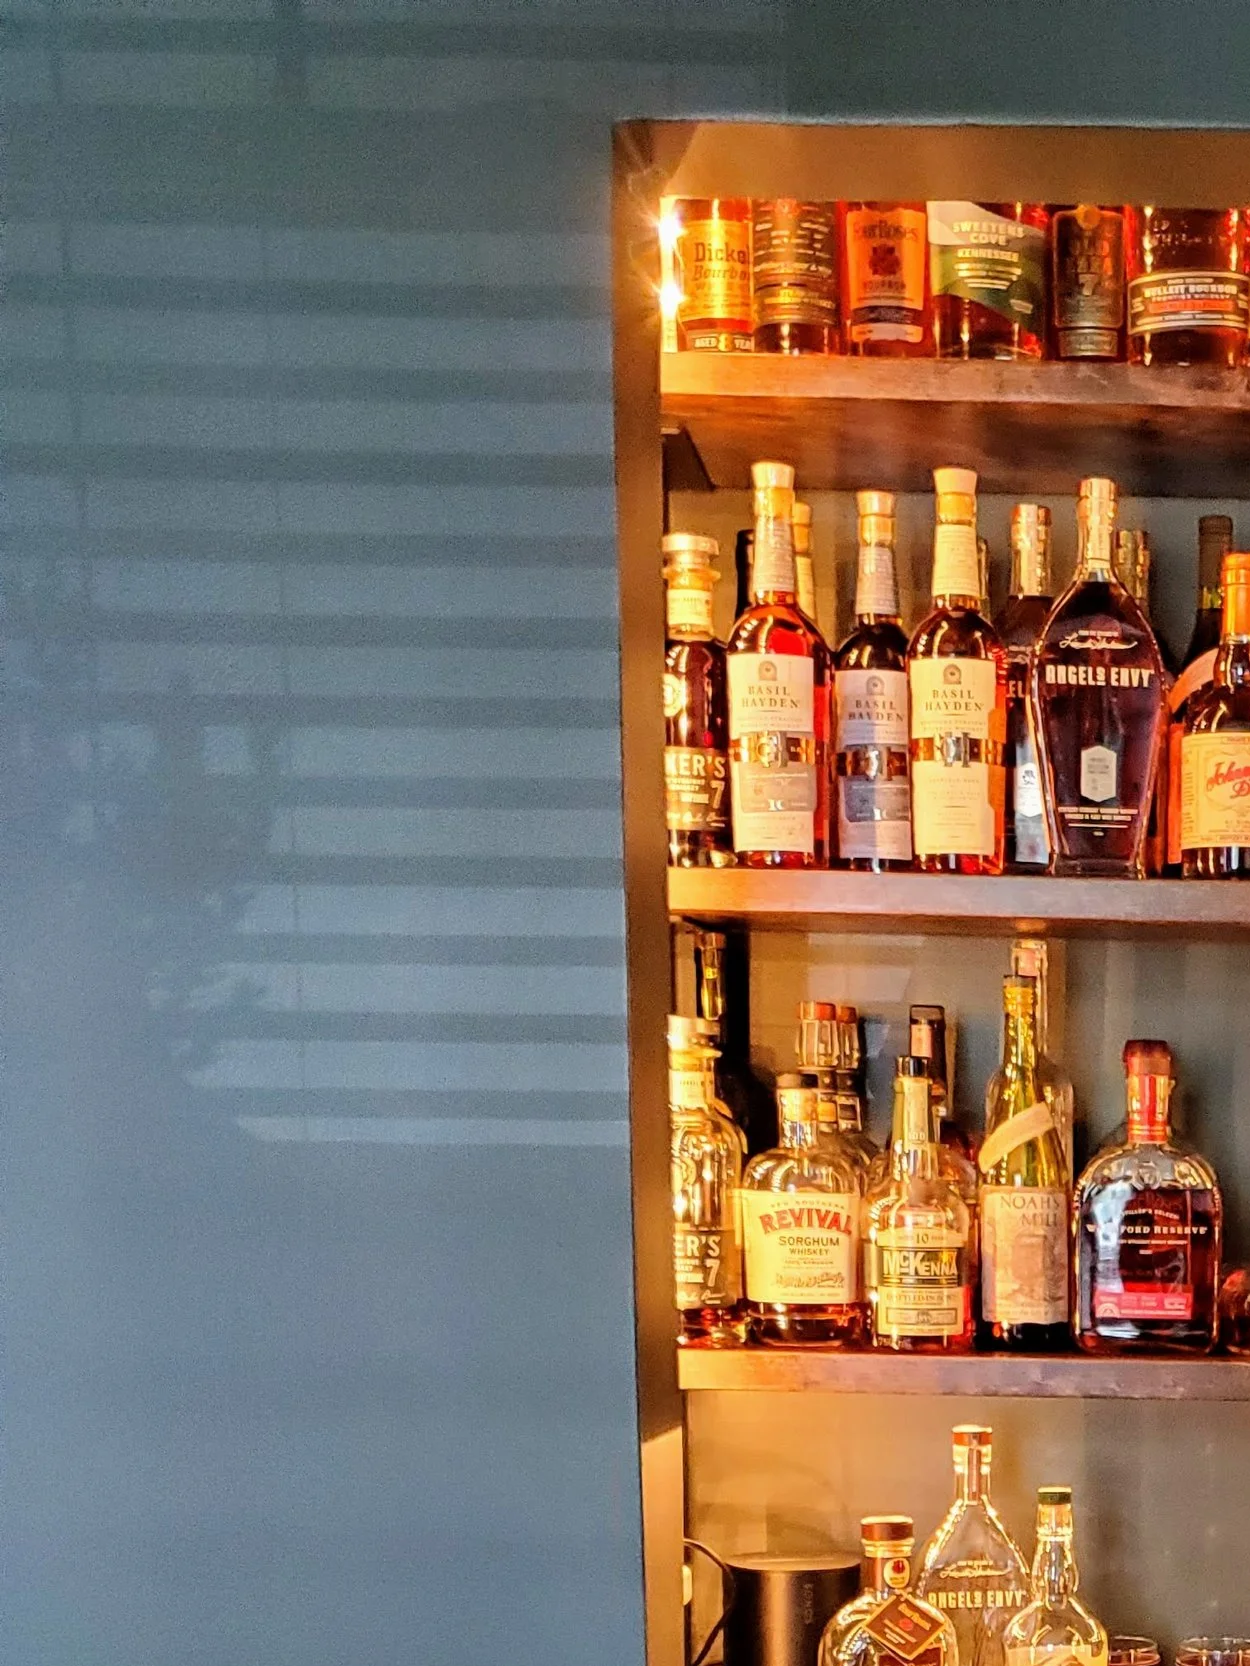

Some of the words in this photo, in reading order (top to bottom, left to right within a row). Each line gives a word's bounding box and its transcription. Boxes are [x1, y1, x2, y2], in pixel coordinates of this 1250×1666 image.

[952, 221, 1024, 238] SWEETENS
[969, 233, 1008, 246] COVE
[1143, 284, 1186, 298] BULLEIT
[1188, 284, 1238, 295] BOURBON
[1045, 664, 1106, 686] ANGELS
[1110, 667, 1155, 688] ENVY
[748, 685, 791, 696] BASIL
[932, 689, 975, 699] BASIL
[741, 698, 799, 709] HAYDEN
[855, 699, 897, 710] BASIL
[925, 701, 984, 711] HAYDEN
[848, 710, 905, 723] HAYDEN
[710, 780, 726, 809] 7
[758, 1207, 852, 1237] REVIVAL
[1085, 1223, 1151, 1234] WFORD
[1153, 1225, 1206, 1235] RESERVE
[778, 1235, 841, 1248] SORGHUM
[916, 1233, 929, 1245] 10
[788, 1247, 830, 1256] WHISKEY
[704, 1258, 721, 1288] 7
[986, 1590, 1025, 1608] ENVY
